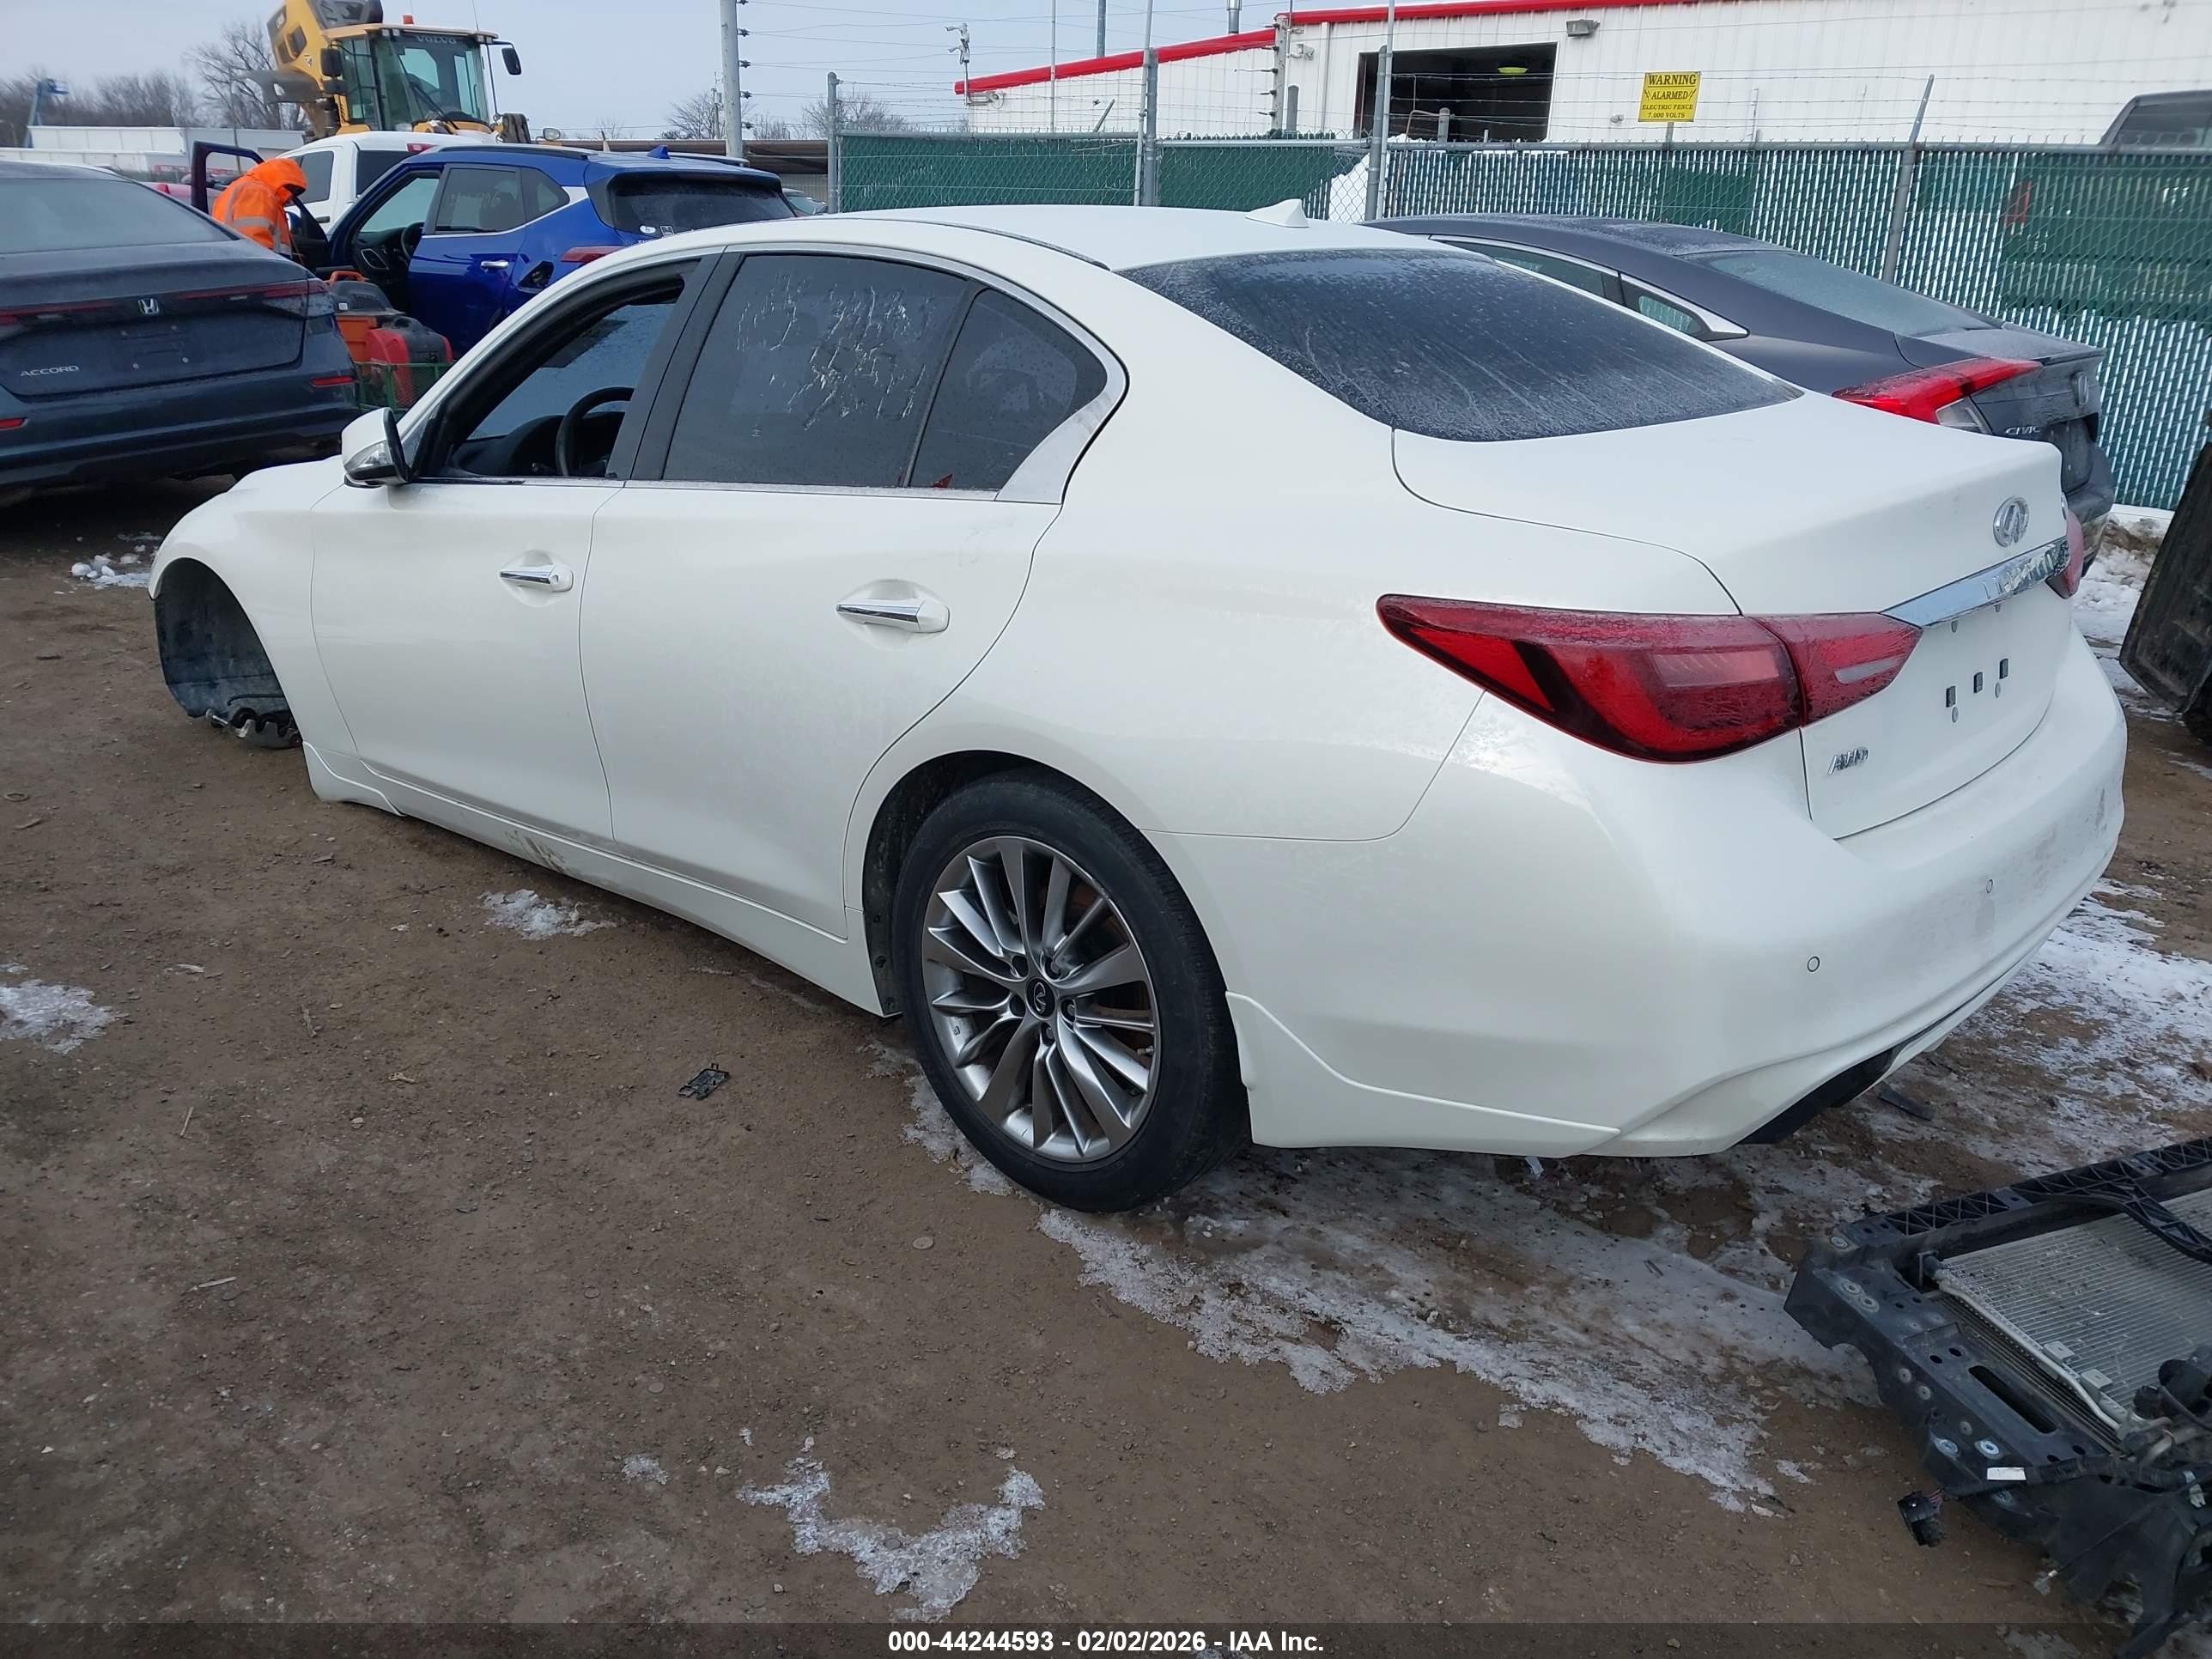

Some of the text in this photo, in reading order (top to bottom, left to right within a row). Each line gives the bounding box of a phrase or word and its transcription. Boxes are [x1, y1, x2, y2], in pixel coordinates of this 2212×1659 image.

[416, 35, 457, 44] VOLVO
[1648, 74, 1697, 85] WARNING
[1650, 90, 1689, 100] ALARMED
[20, 365, 79, 378] ACCORD
[2005, 425, 2041, 435] CIVIC
[1827, 747, 1869, 775] AWD
